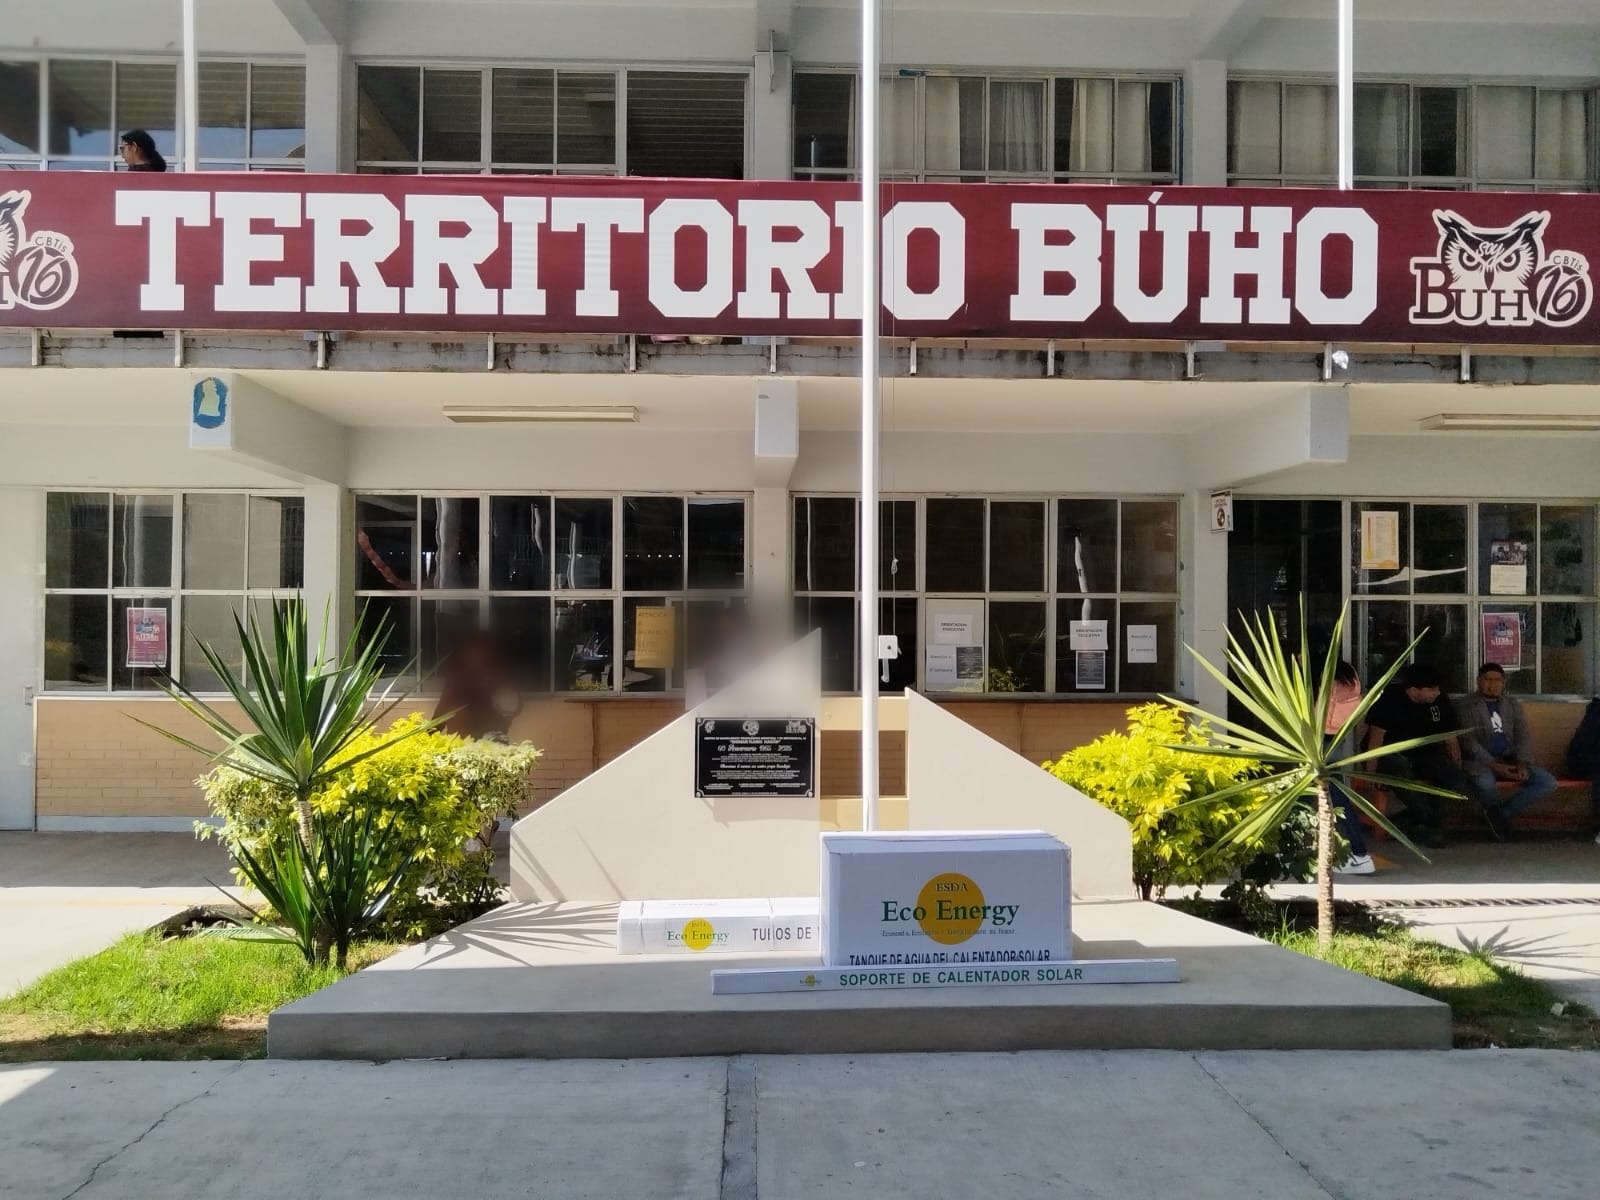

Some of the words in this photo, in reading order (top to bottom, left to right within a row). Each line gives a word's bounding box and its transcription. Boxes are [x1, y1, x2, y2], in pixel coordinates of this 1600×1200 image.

[115, 190, 966, 321] TERRITORIO
[1010, 191, 1379, 326] BÚHO
[20, 247, 66, 302] 16
[936, 883, 968, 892] ESDA
[881, 901, 927, 921] Eco
[936, 900, 1020, 926] Energy
[667, 930, 688, 941] Eco
[692, 930, 730, 942] Energy
[796, 926, 812, 940] DE
[839, 973, 905, 986] SOPORTE
[912, 971, 931, 984] DE
[938, 969, 1030, 983] CALENTADOR
[1037, 968, 1083, 981] SOLAR
